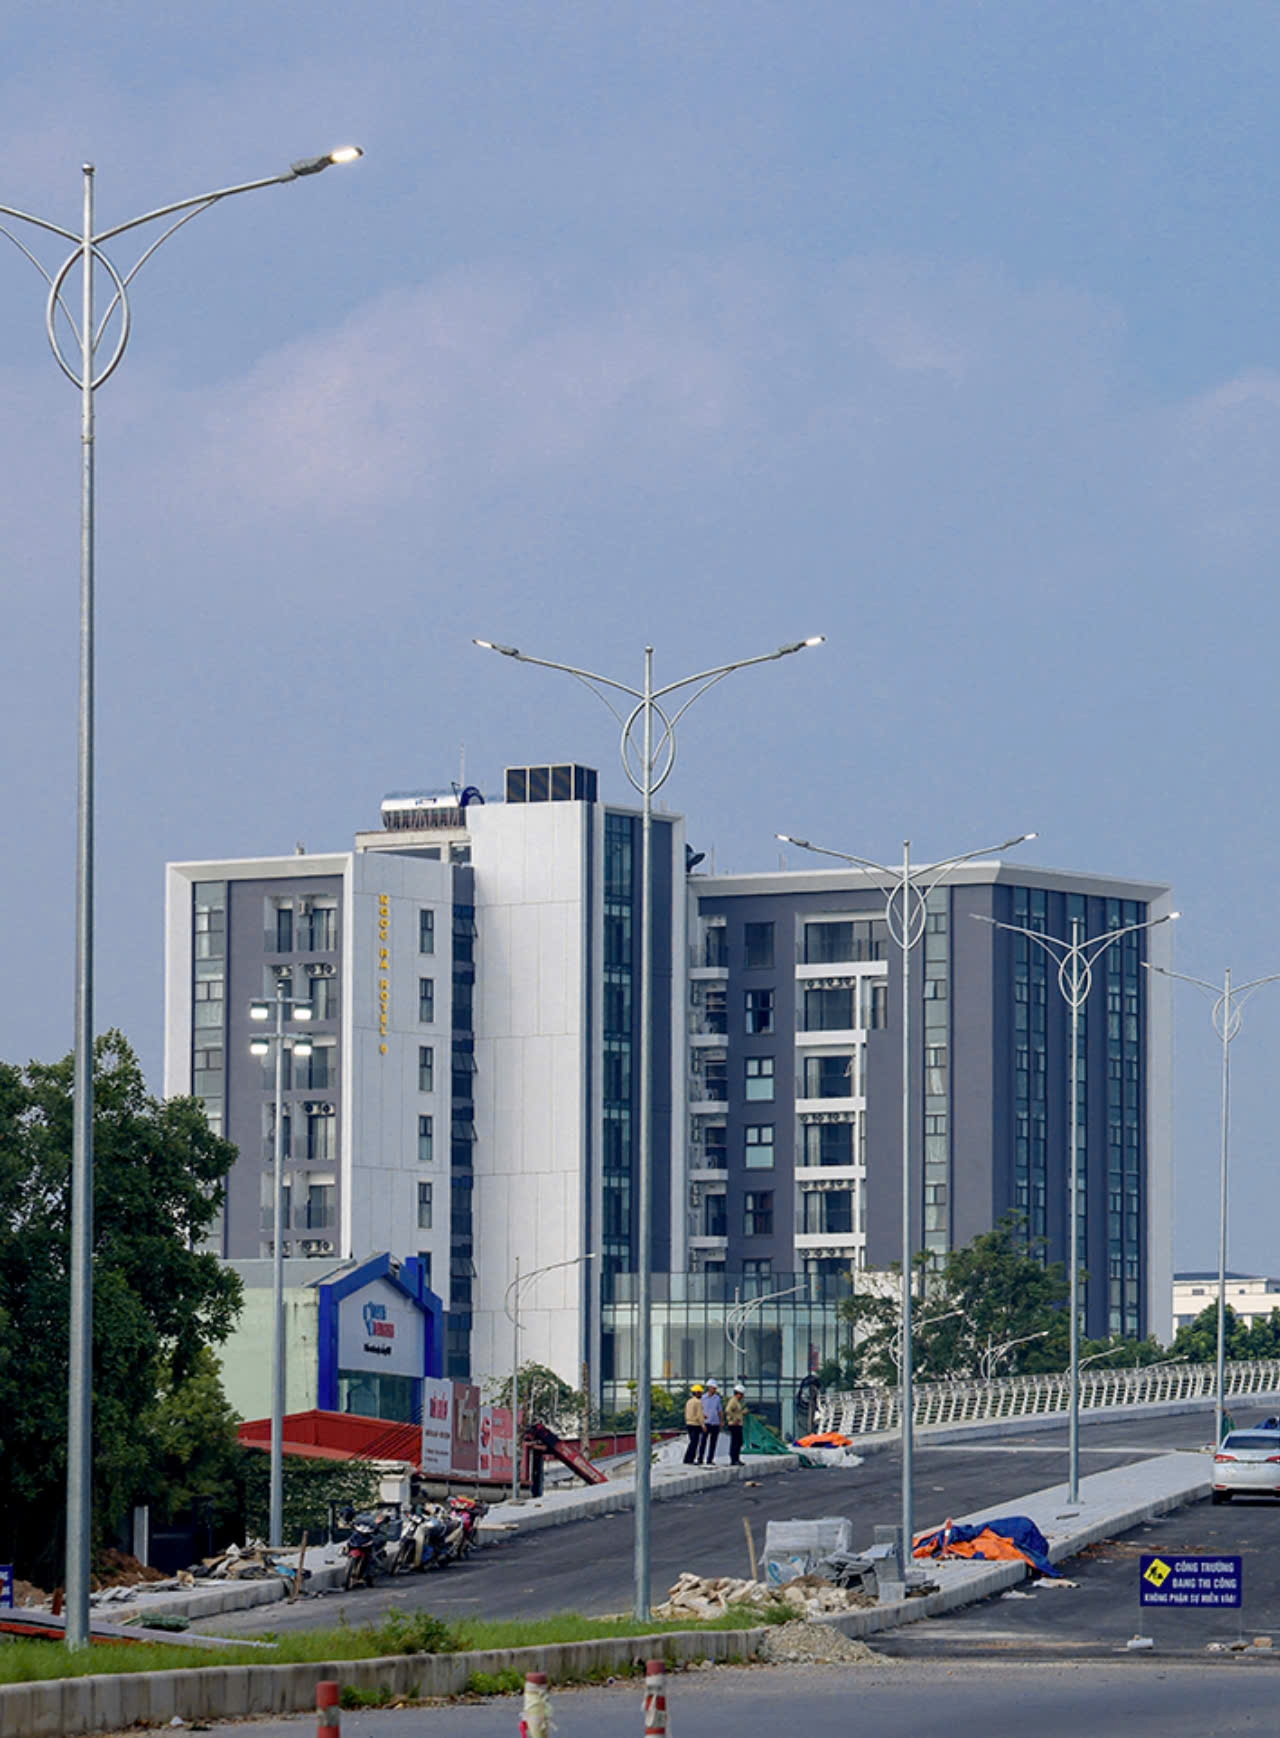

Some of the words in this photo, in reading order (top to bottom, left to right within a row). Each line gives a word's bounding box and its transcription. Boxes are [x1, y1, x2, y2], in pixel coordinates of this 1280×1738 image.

[379, 979, 390, 1035] HOTEL
[1175, 1560, 1198, 1573] CÔNG
[1199, 1578, 1211, 1588] THI
[1213, 1577, 1236, 1588] CÔNG
